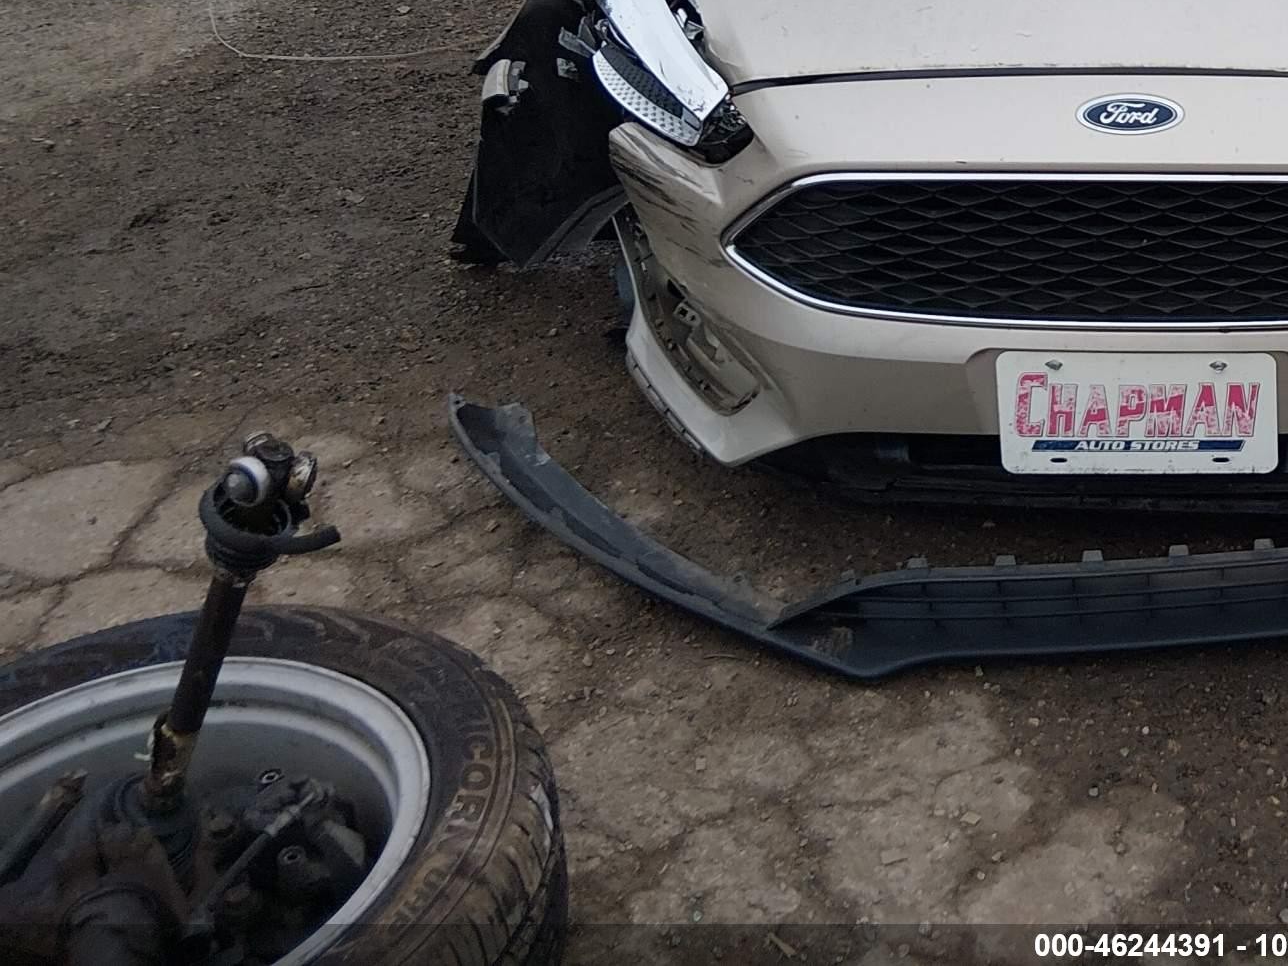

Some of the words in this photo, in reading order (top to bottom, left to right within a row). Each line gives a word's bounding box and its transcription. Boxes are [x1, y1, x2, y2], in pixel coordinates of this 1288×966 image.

[1099, 102, 1159, 124] Ford
[1014, 371, 1260, 438] CHAPMAN
[1075, 440, 1125, 451] AUTO
[1129, 440, 1199, 451] STORES
